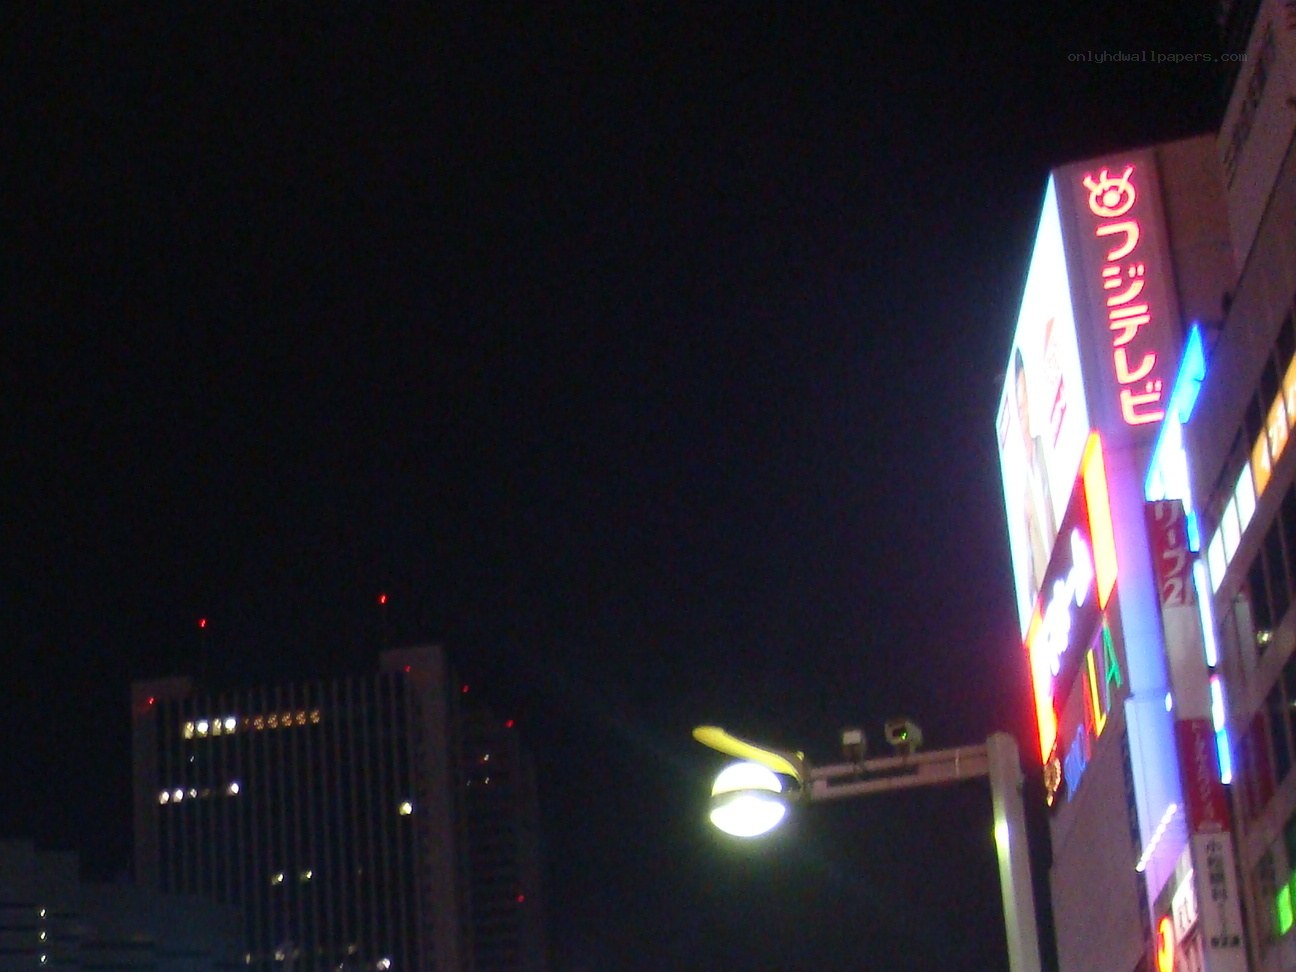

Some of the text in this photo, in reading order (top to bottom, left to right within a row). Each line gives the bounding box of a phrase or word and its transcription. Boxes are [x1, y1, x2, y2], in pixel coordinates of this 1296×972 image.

[1095, 221, 1165, 426] フジテレビ
